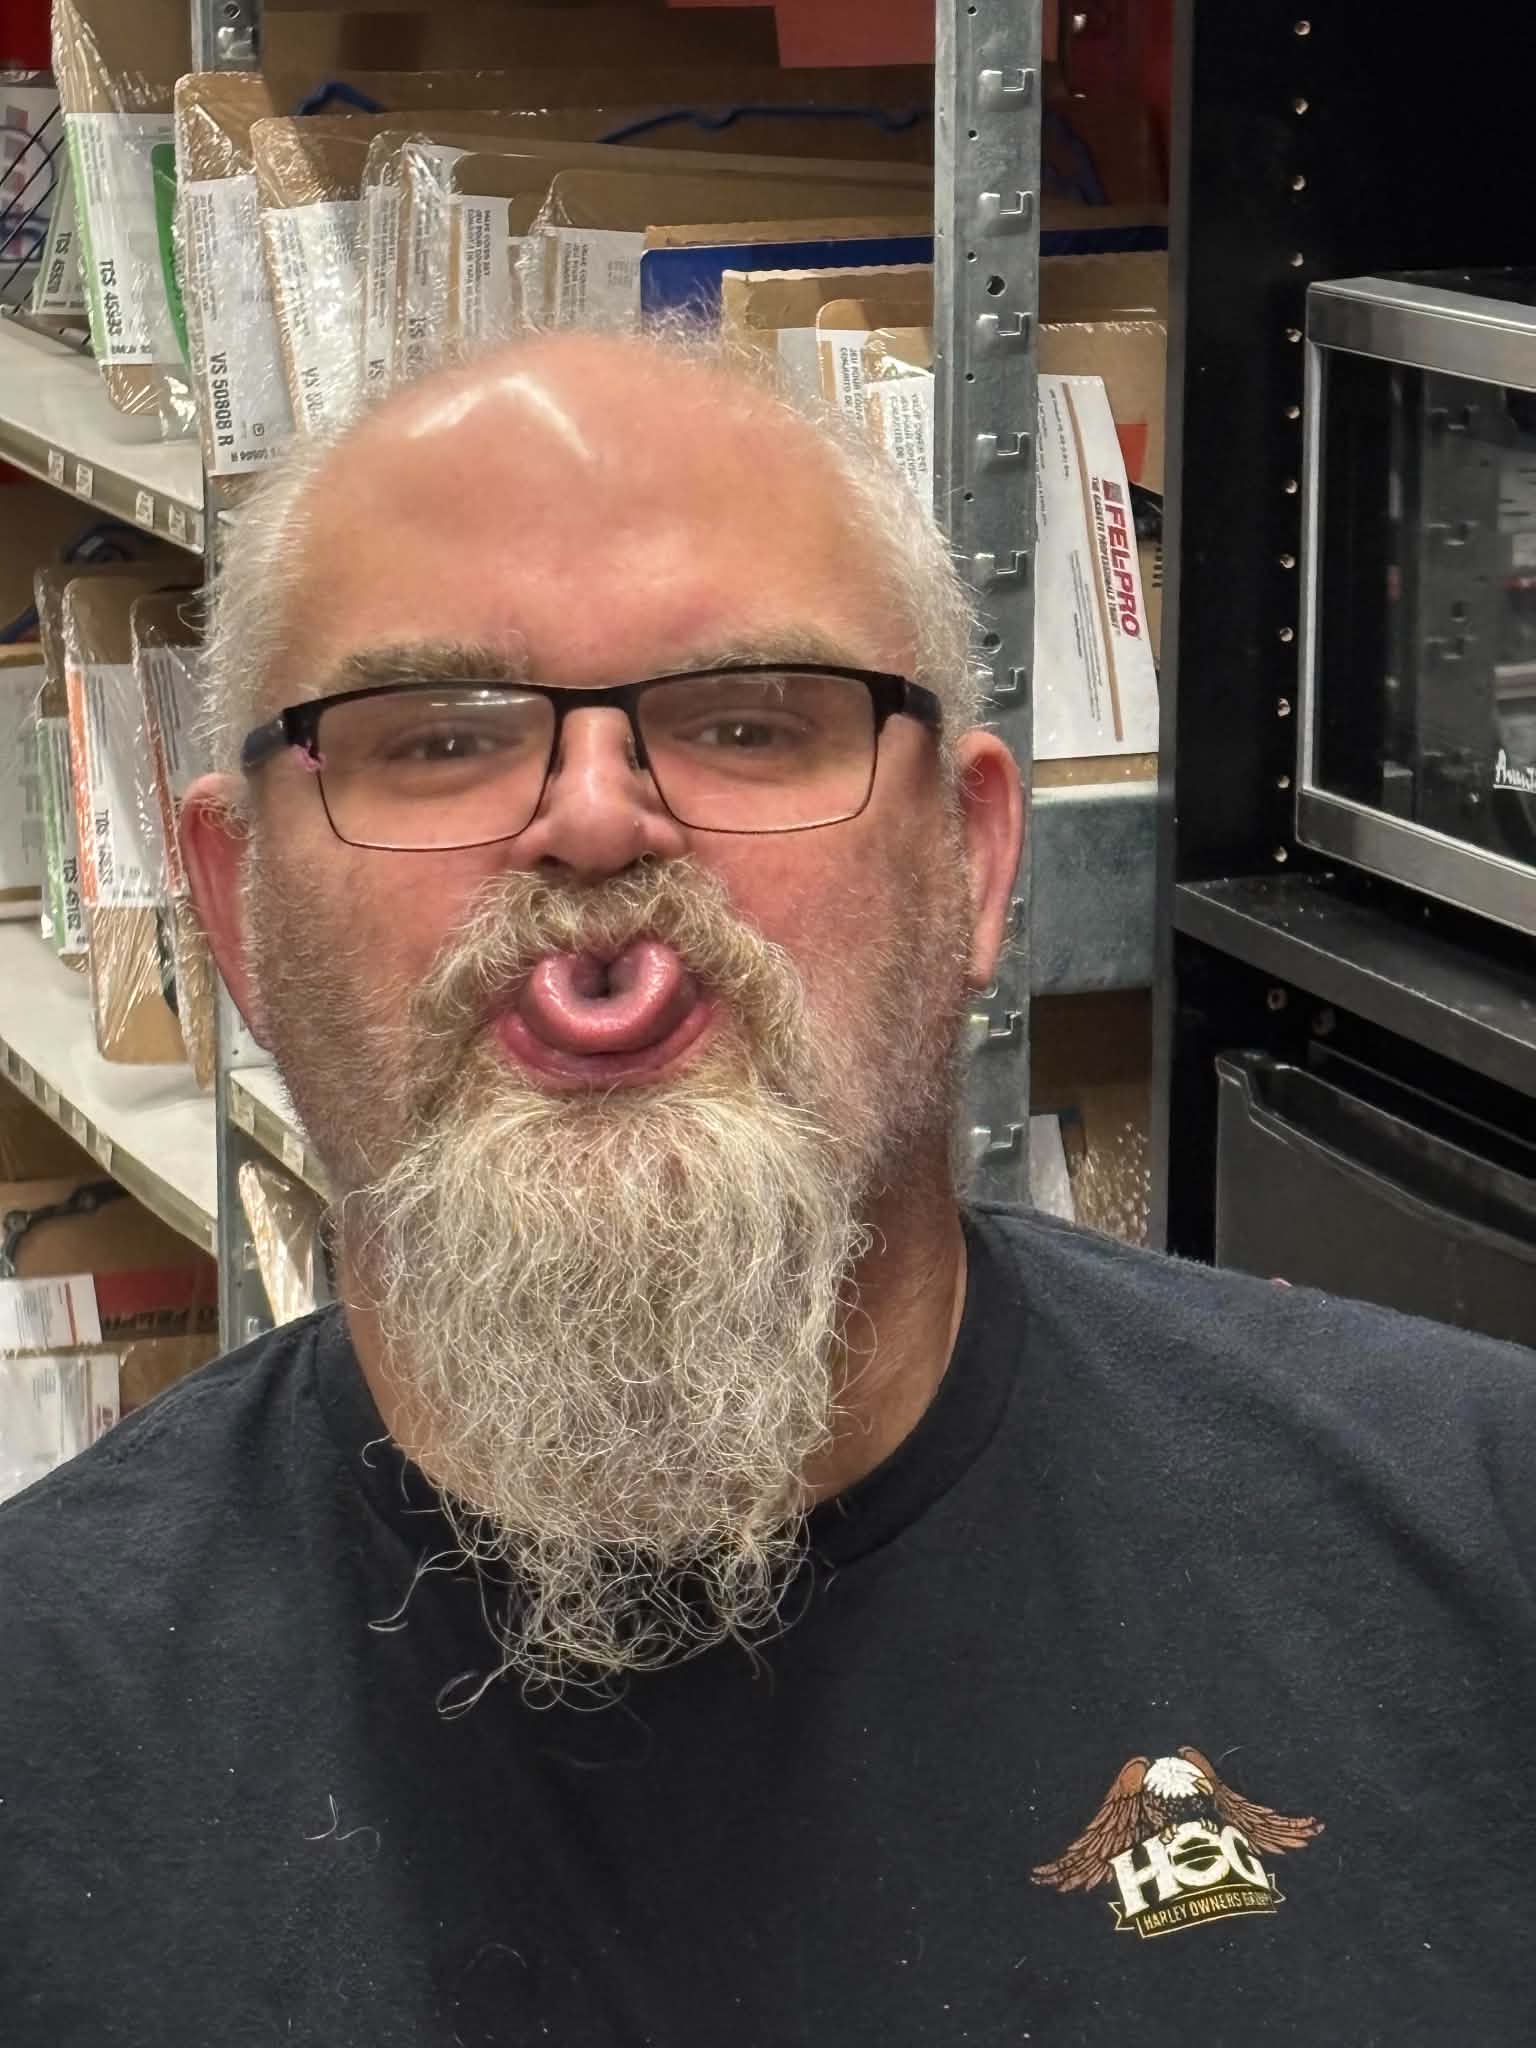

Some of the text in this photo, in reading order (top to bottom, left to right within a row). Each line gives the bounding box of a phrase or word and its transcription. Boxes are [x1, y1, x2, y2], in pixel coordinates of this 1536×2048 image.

[100, 259, 116, 286] TCS
[210, 352, 234, 447] VS 50808 R
[1105, 505, 1140, 637] FEL-PRO
[1143, 1904, 1187, 1931] HARLEY
[1189, 1893, 1241, 1917] OWNERS
